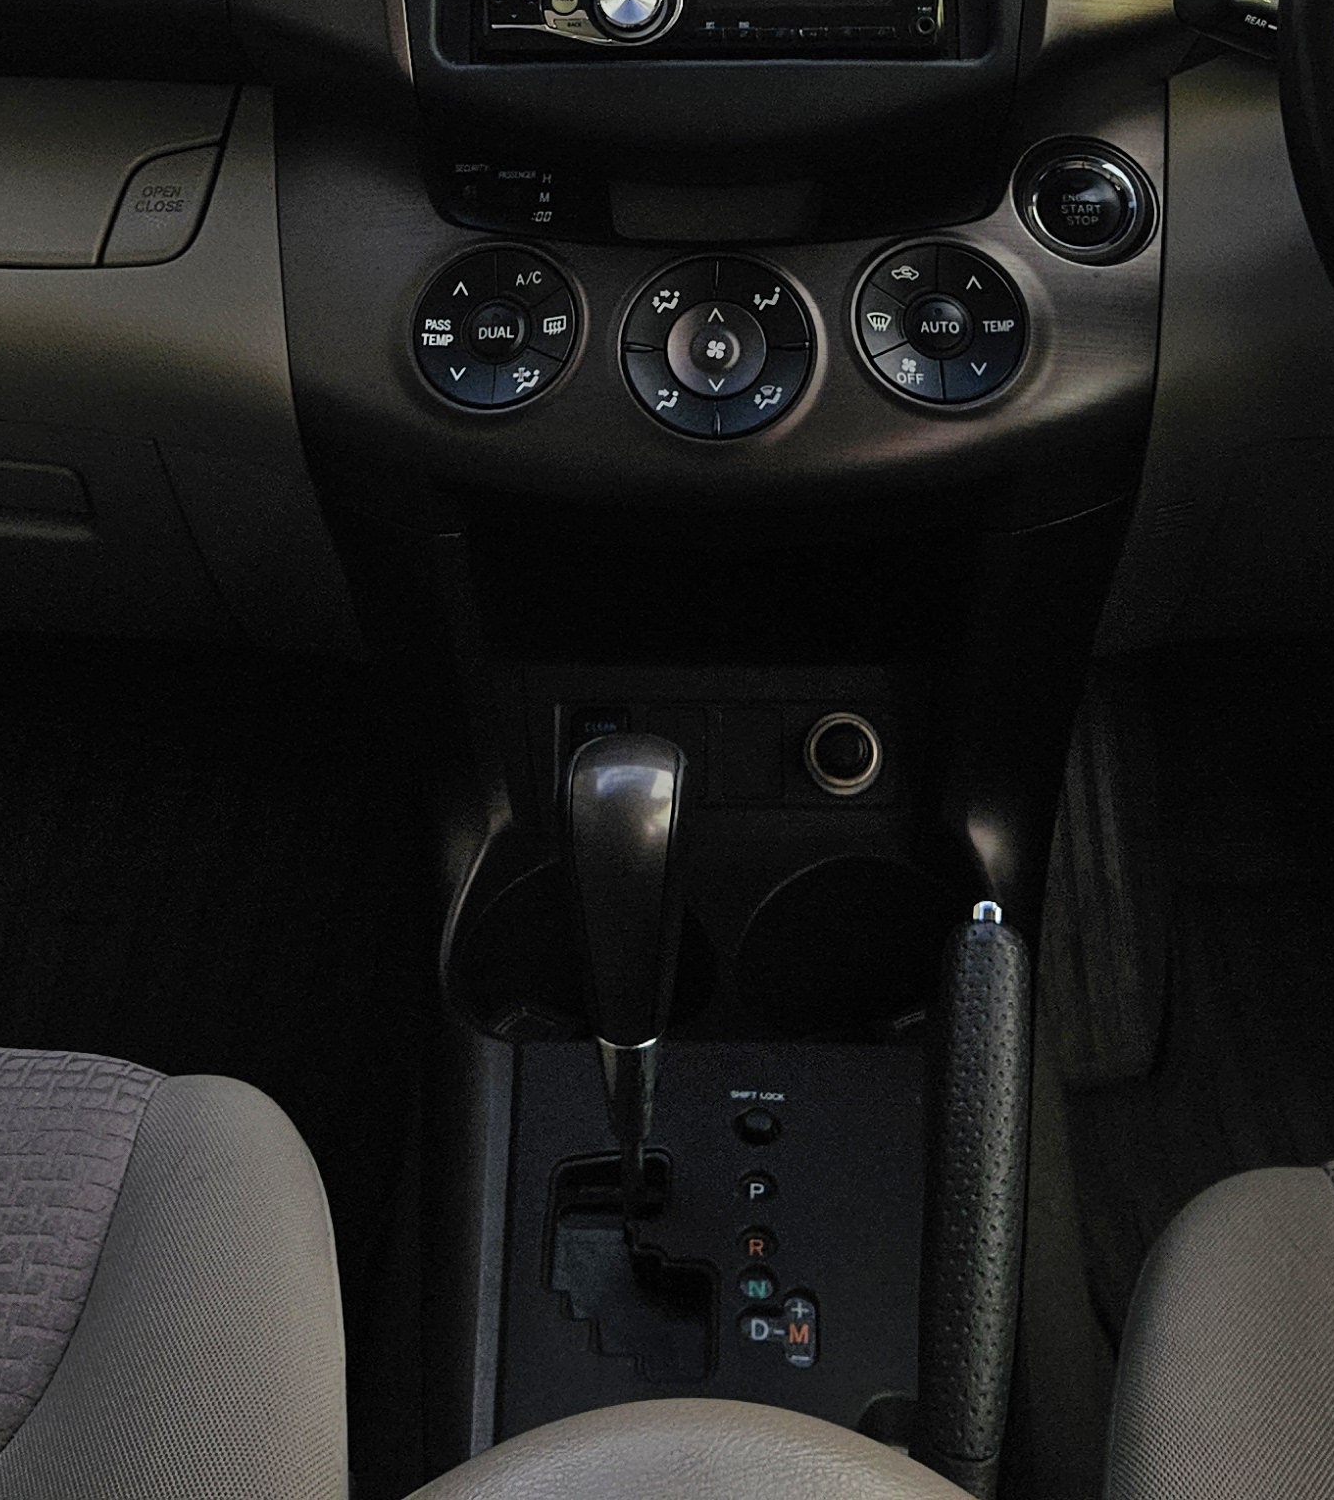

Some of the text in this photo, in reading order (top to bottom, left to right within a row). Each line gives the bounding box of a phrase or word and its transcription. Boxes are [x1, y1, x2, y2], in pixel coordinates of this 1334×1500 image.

[1243, 13, 1268, 30] REAR
[455, 163, 489, 173] SECURITY
[498, 170, 537, 179] PASSENGER
[542, 173, 553, 184] H
[142, 185, 182, 199] OPEN
[539, 191, 551, 203] M
[135, 199, 185, 213] CLOSE
[1061, 203, 1101, 215] START
[1066, 215, 1100, 226] STOP
[515, 270, 542, 286] A/C
[424, 318, 452, 332] PASS
[920, 320, 960, 335] AUTO
[982, 319, 1015, 333] TEMP
[478, 325, 515, 340] DUAL
[421, 333, 454, 347] TEMP
[896, 372, 924, 385] OFF
[730, 1089, 786, 1102] SHIFT LOCK
[749, 1183, 765, 1199] P
[748, 1239, 764, 1256] R
[748, 1279, 766, 1299] N
